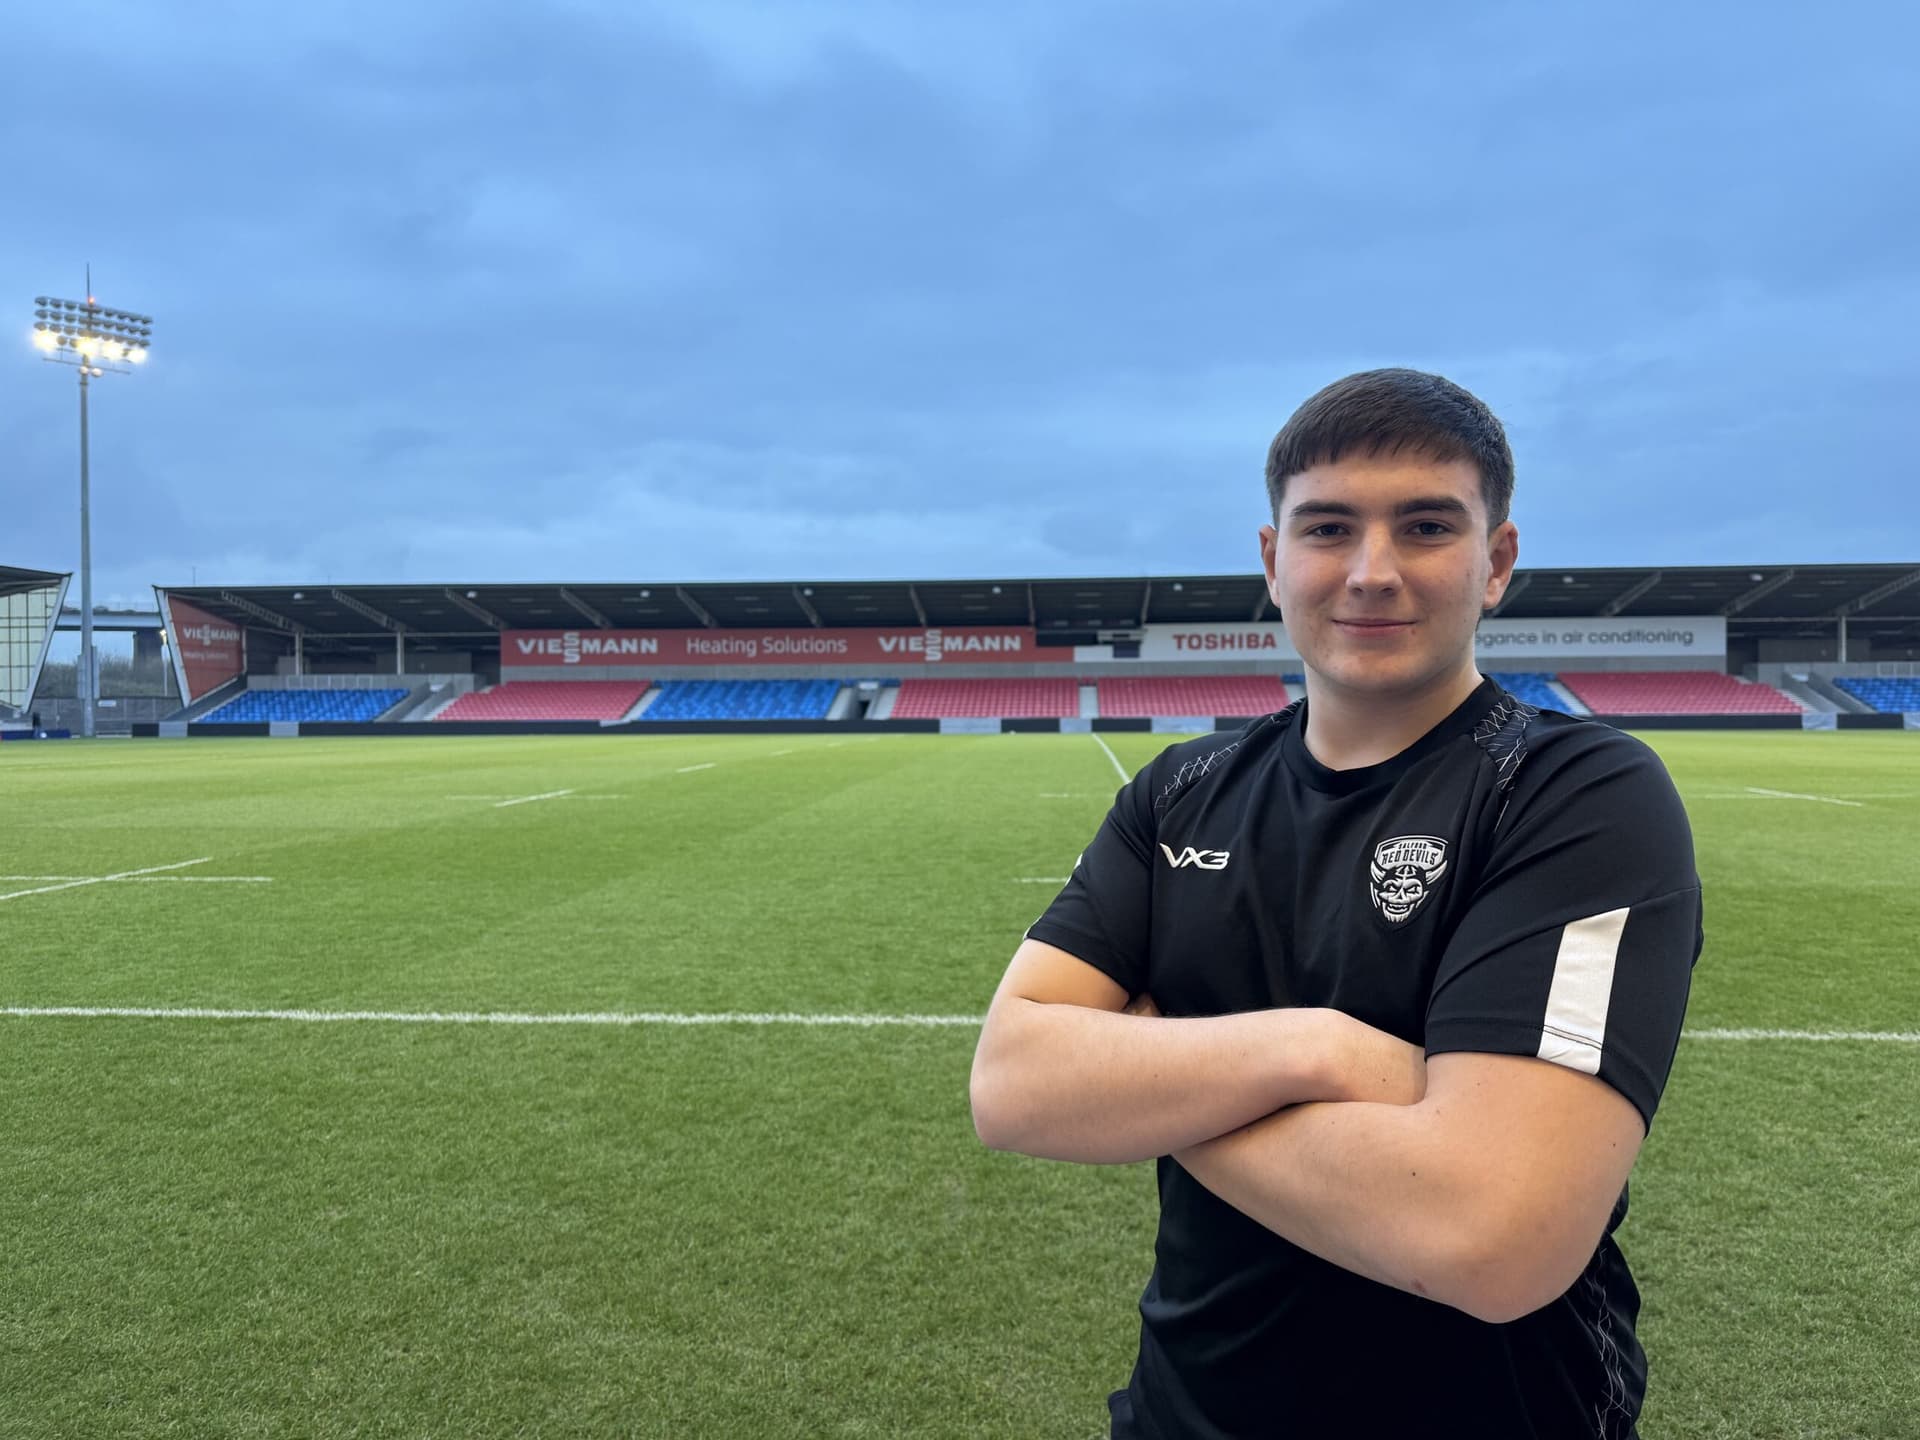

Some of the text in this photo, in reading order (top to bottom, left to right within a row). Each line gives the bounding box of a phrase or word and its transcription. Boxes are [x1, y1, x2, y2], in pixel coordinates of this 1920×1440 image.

[517, 629, 1021, 663] VIESSMANN Heating Solutions VIESSMANN
[1173, 633, 1276, 650] TOSHIBA
[1542, 630, 1557, 644] in
[1562, 630, 1584, 644] air
[1588, 629, 1694, 646] conditioning
[1381, 848, 1439, 866] RED DEVILS
